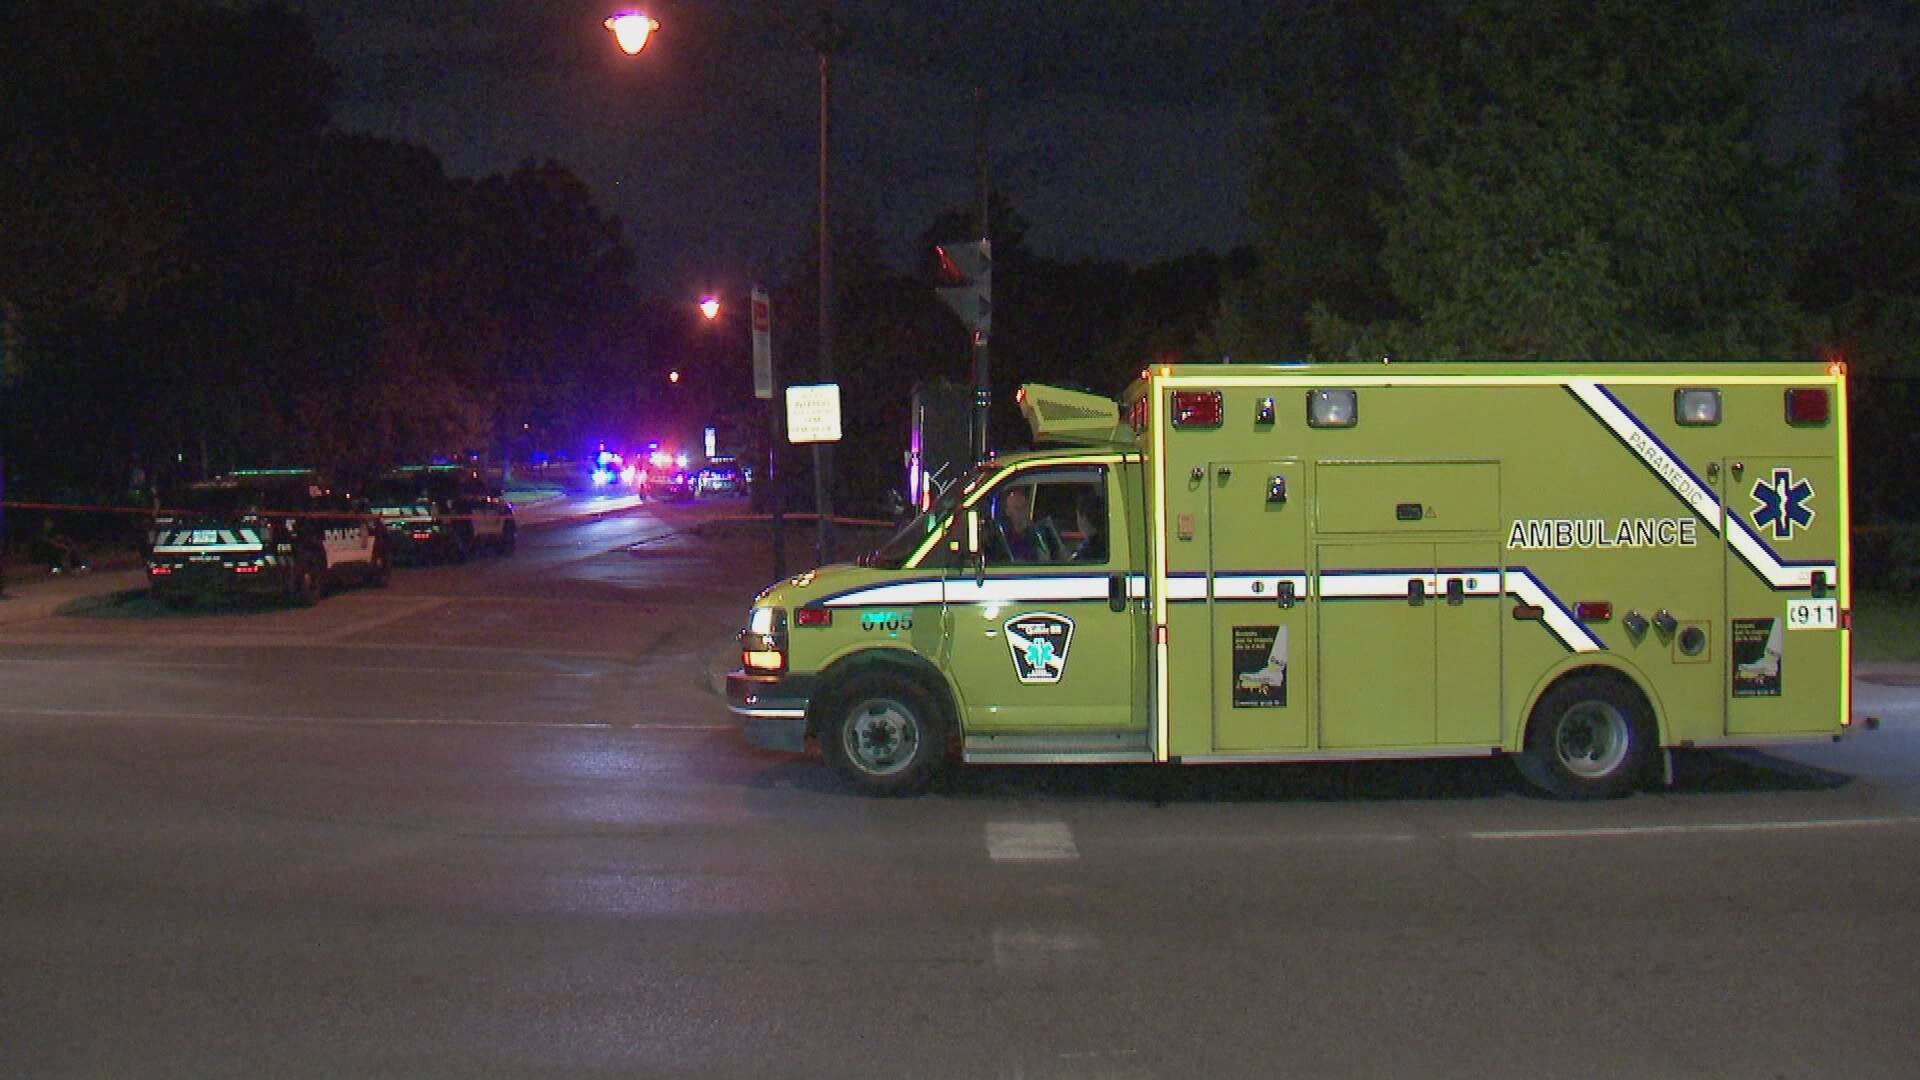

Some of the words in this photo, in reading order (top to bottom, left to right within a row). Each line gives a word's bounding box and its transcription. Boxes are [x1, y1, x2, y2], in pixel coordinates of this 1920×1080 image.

[1630, 431, 1703, 505] PARAMEDIC
[1507, 517, 1697, 549] AMBULANCE
[1797, 605, 1834, 624] 911
